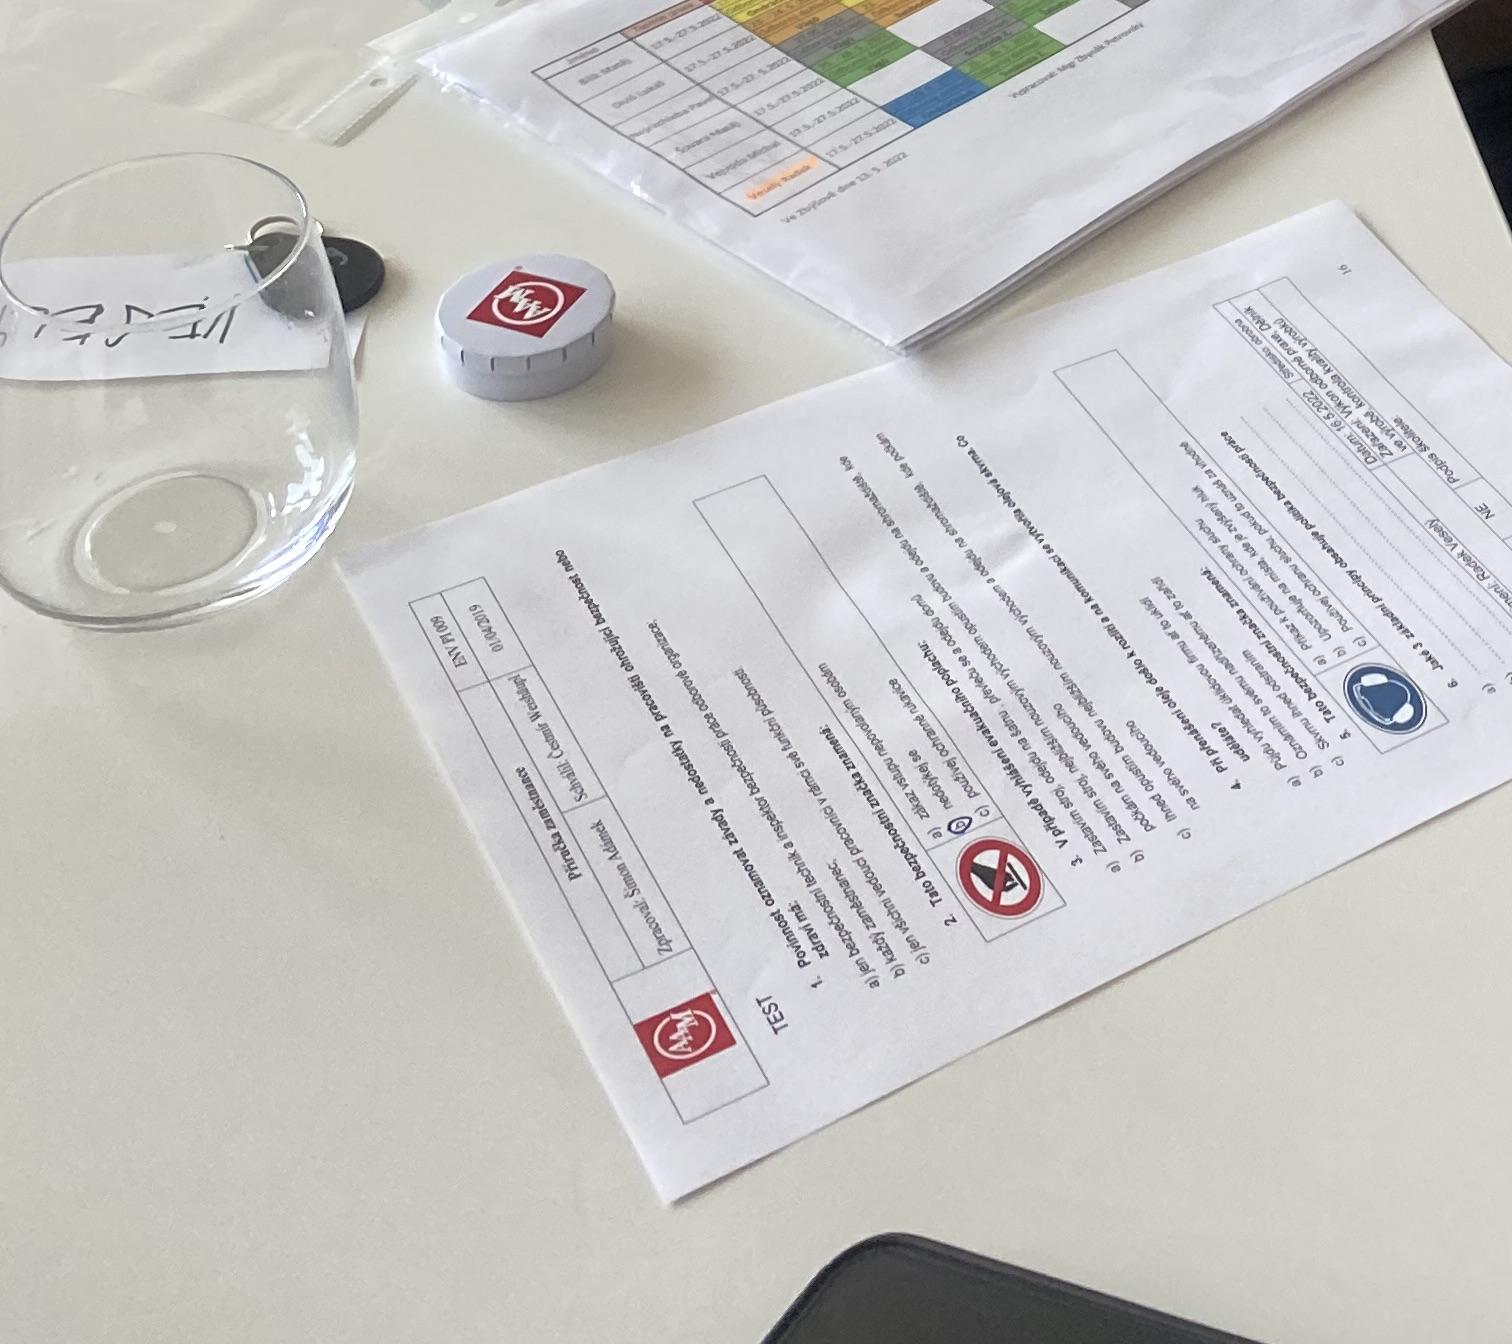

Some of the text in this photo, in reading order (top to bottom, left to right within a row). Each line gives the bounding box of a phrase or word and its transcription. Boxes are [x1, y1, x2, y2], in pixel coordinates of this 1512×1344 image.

[1336, 262, 1352, 276] 16
[1472, 501, 1496, 520] NE
[428, 614, 469, 669] ENV PI 009
[467, 602, 504, 653] 01/04/2019
[554, 548, 824, 989] 1. Povinnost oznamovat závady a nedostatky na pracovišti ohrožující bezpečnost nebo
[907, 747, 954, 810] nedotýkej se
[916, 638, 1084, 867] 3. V případě vyhlášení evakuačního poplachu:
[818, 722, 958, 927] 2. Tato bezpečnostní značka znamená:
[786, 898, 830, 959] zdraví má:
[754, 994, 789, 1036] TEST
